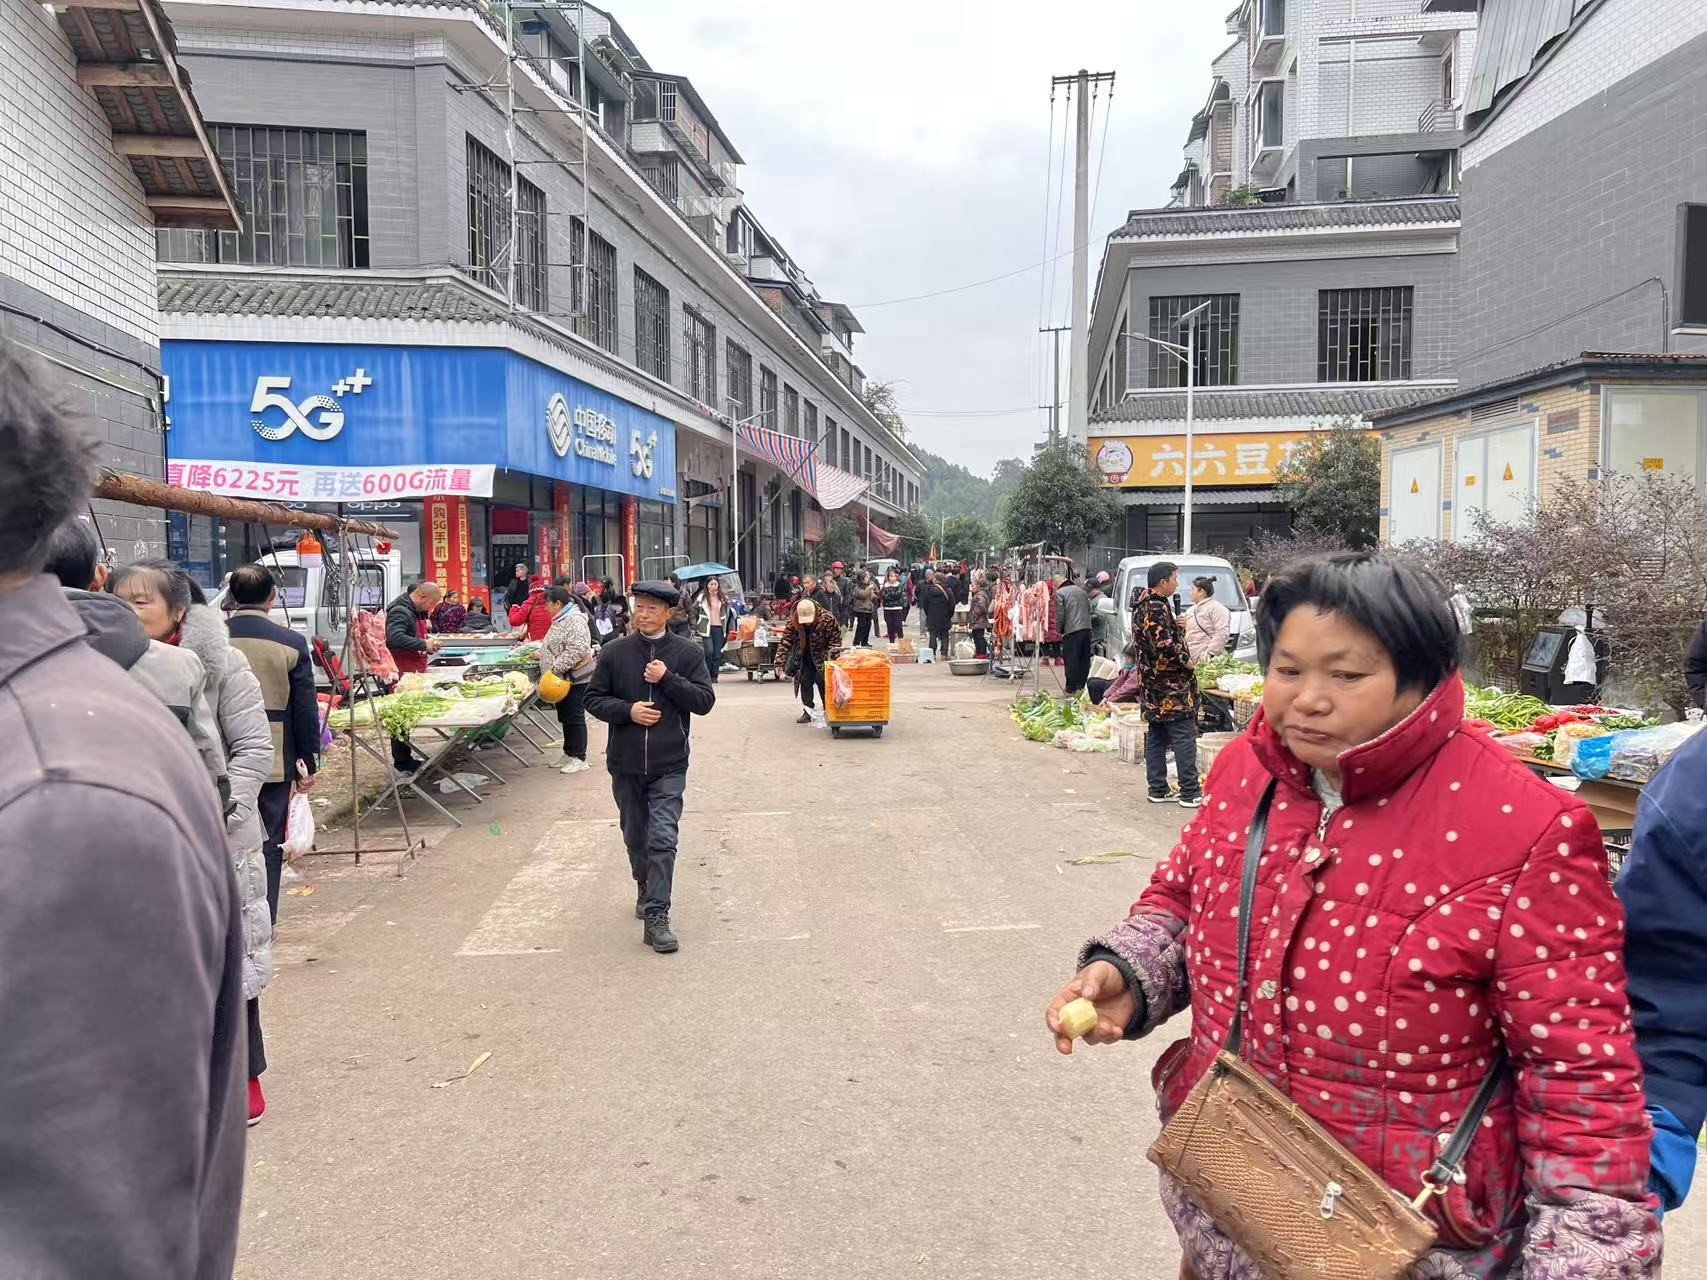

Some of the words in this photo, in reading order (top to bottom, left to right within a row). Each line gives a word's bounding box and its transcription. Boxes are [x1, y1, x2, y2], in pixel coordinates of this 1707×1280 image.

[573, 403, 616, 445] 中国移动
[168, 463, 299, 496] 直降6225元
[313, 468, 472, 497] 再送600G流量
[433, 506, 447, 558] 购5G手机
